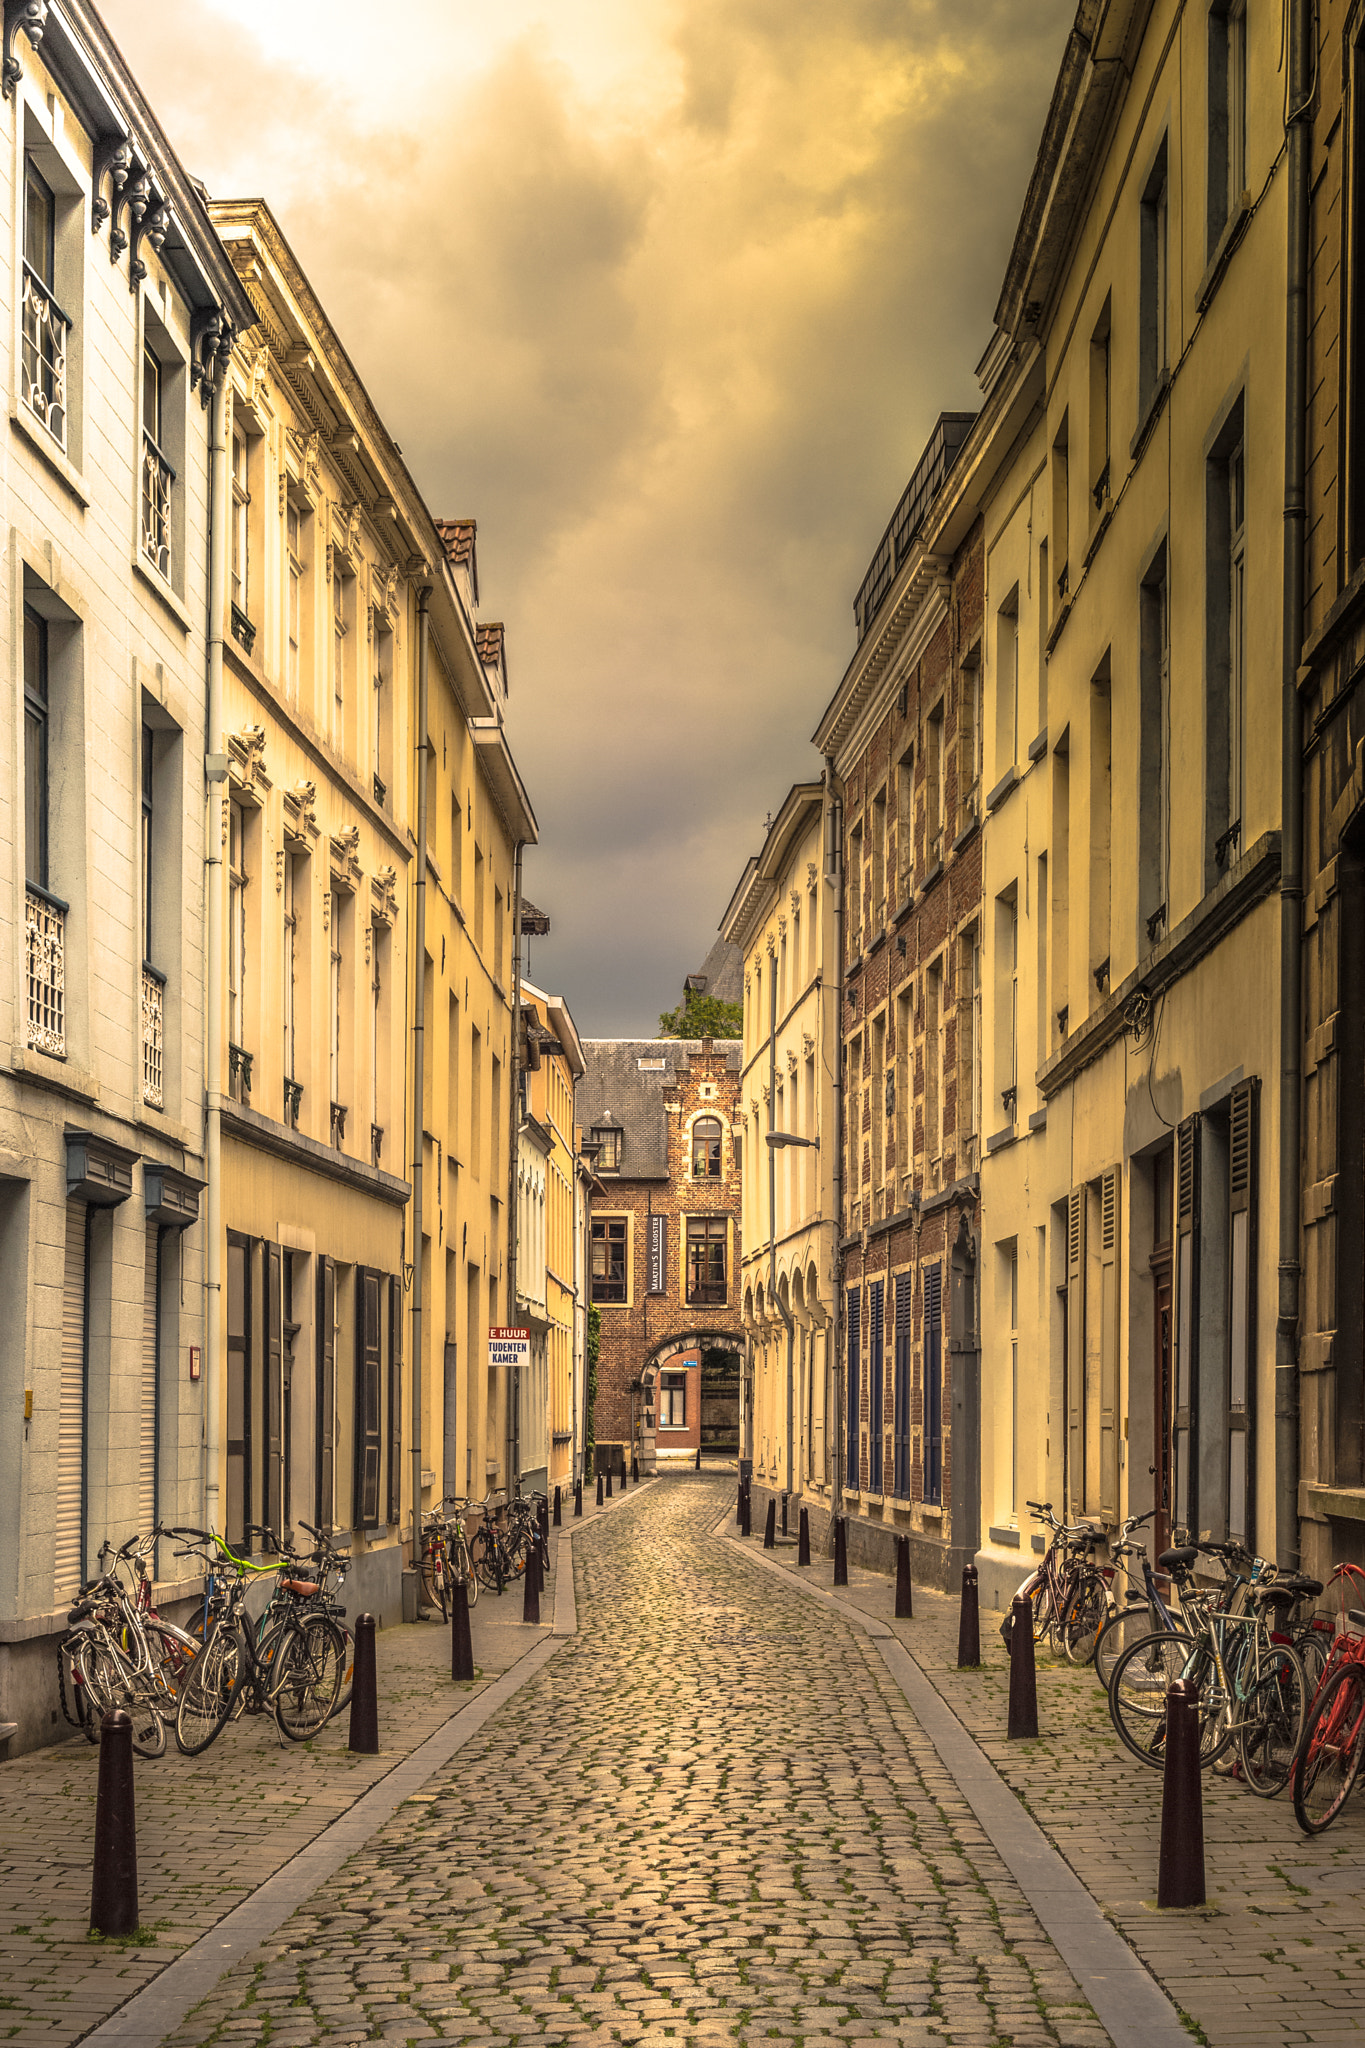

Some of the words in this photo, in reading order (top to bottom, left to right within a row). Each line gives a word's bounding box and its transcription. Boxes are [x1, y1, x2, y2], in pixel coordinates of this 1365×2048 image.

[651, 1217, 659, 1252] KLOOSTER
[651, 1255, 659, 1290] MARTIN'S
[499, 1329, 527, 1338] HUUR
[488, 1342, 527, 1352] TUDENTEN
[492, 1353, 519, 1364] KAMER
